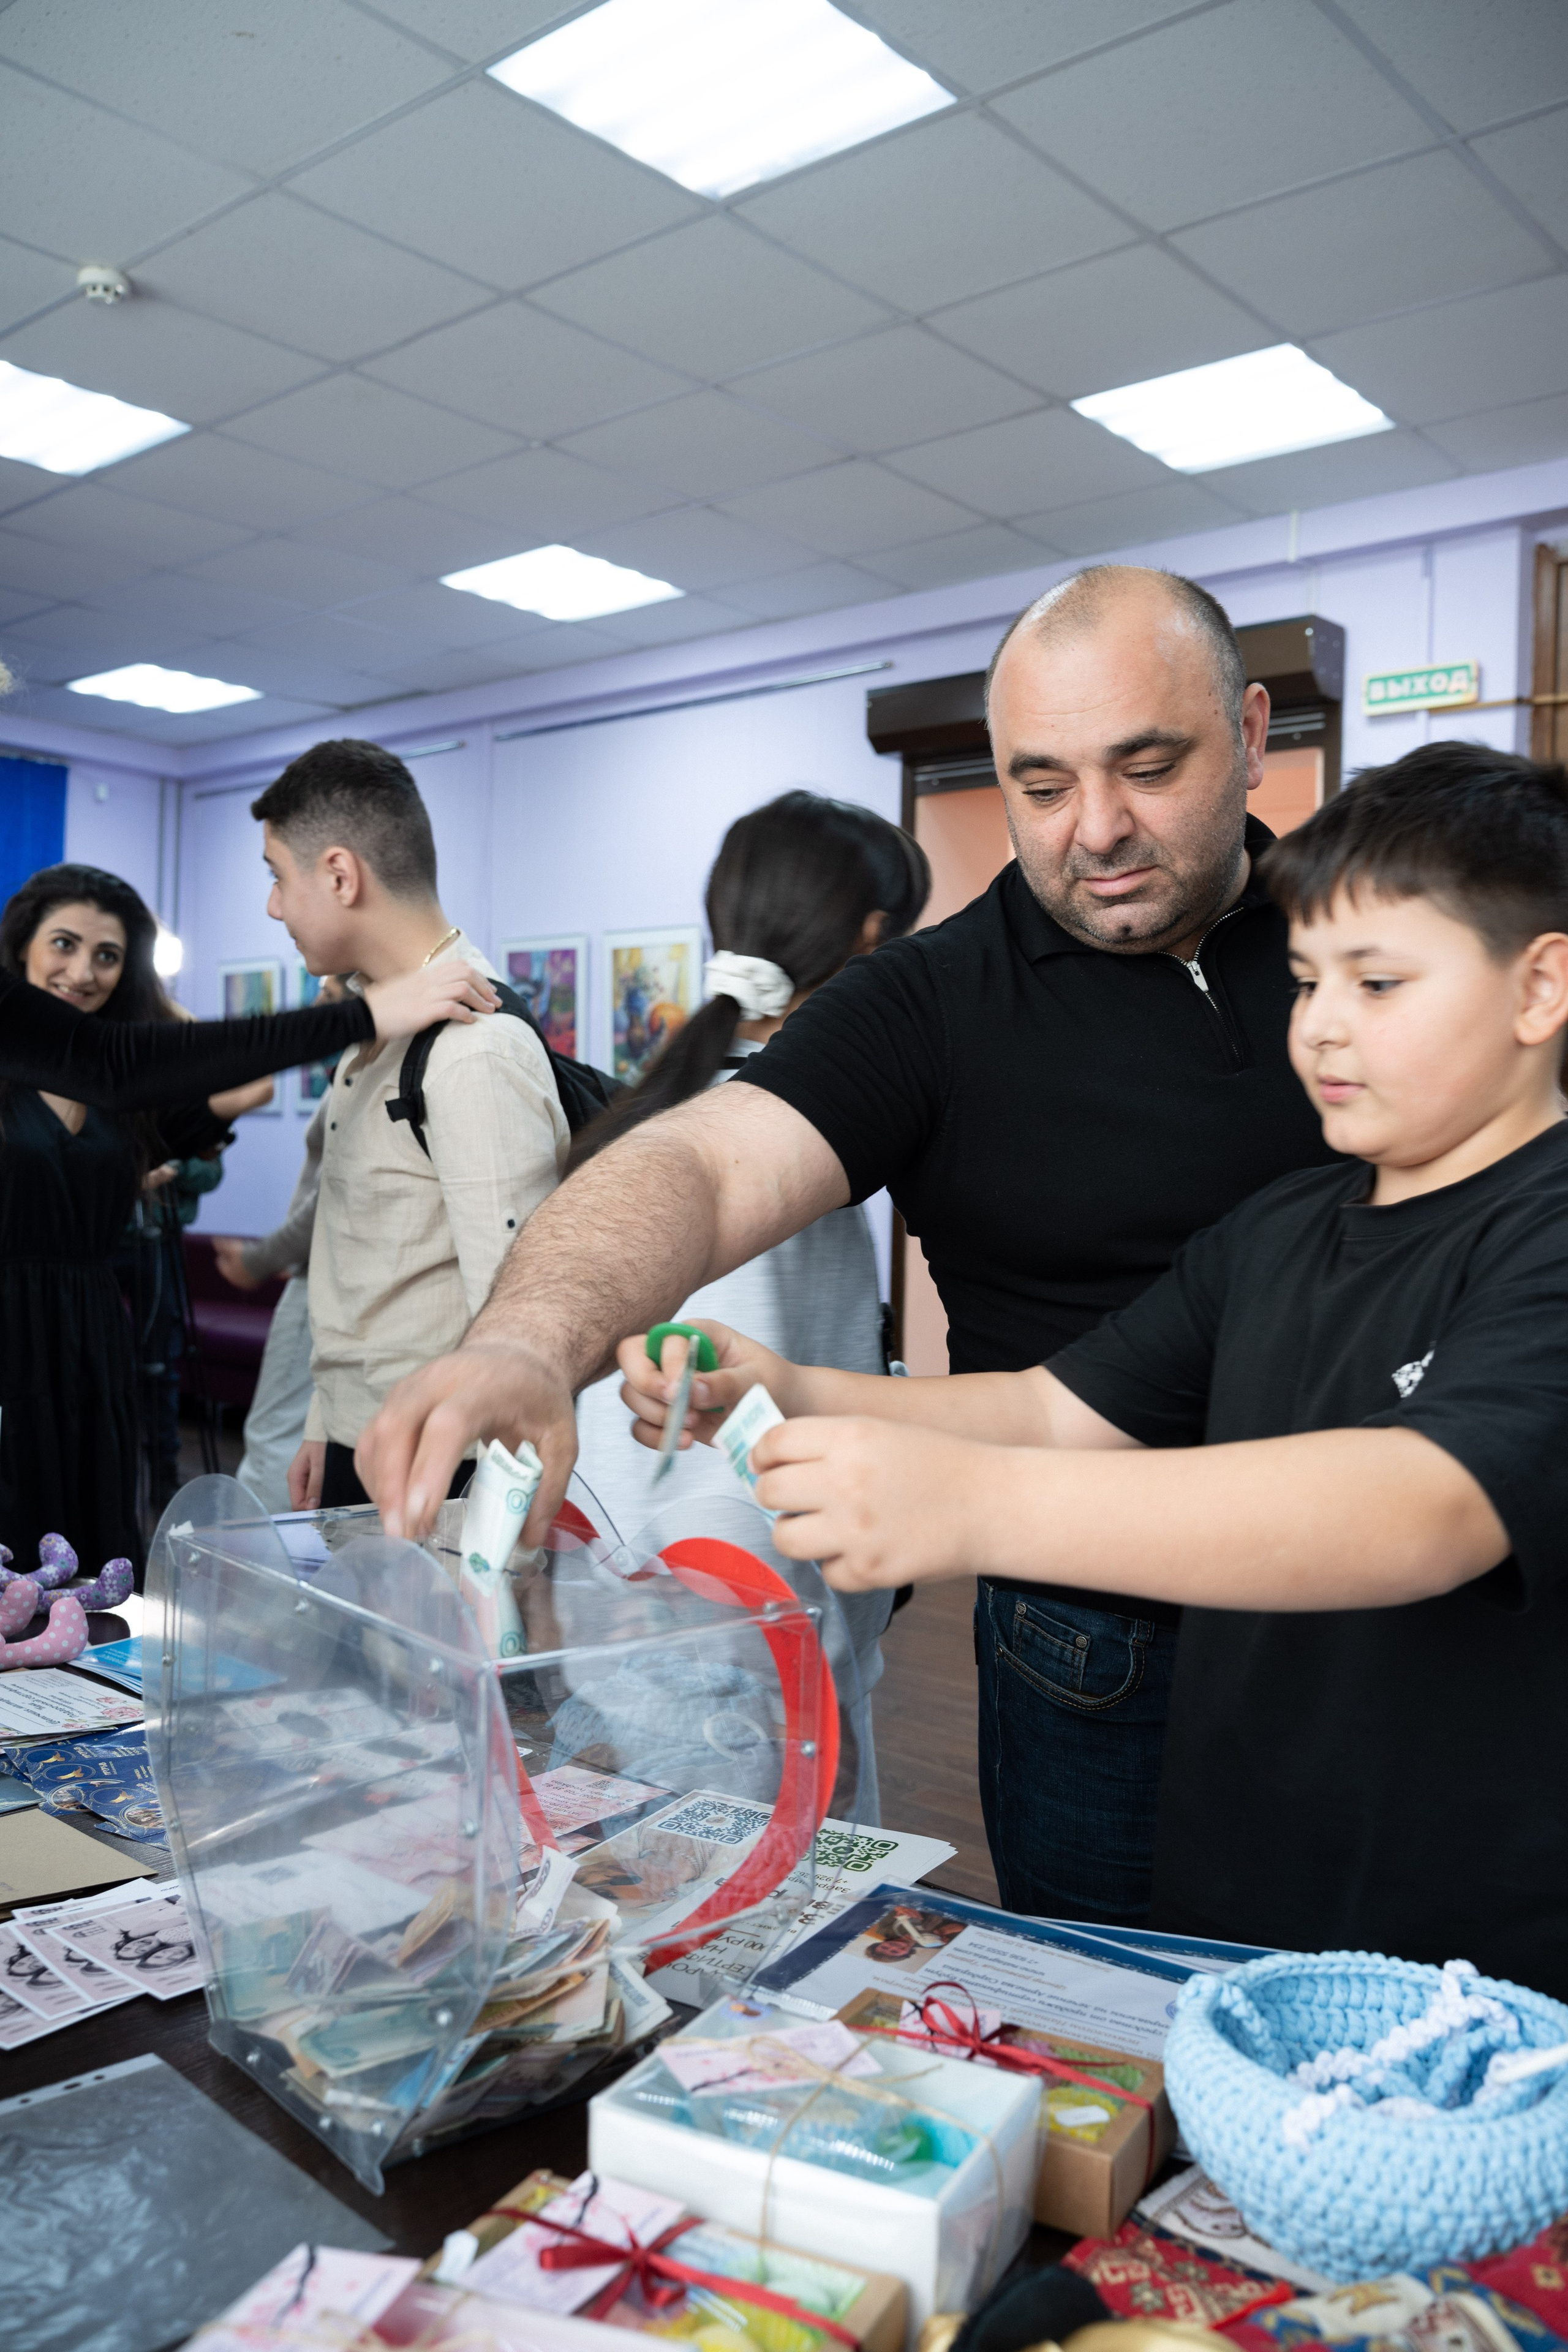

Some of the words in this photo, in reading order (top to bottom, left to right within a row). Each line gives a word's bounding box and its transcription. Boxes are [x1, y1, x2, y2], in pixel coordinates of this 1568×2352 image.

[1369, 669, 1468, 701] ВЫХОД
[968, 1942, 986, 1952] 234
[986, 1946, 1011, 1959] 5555
